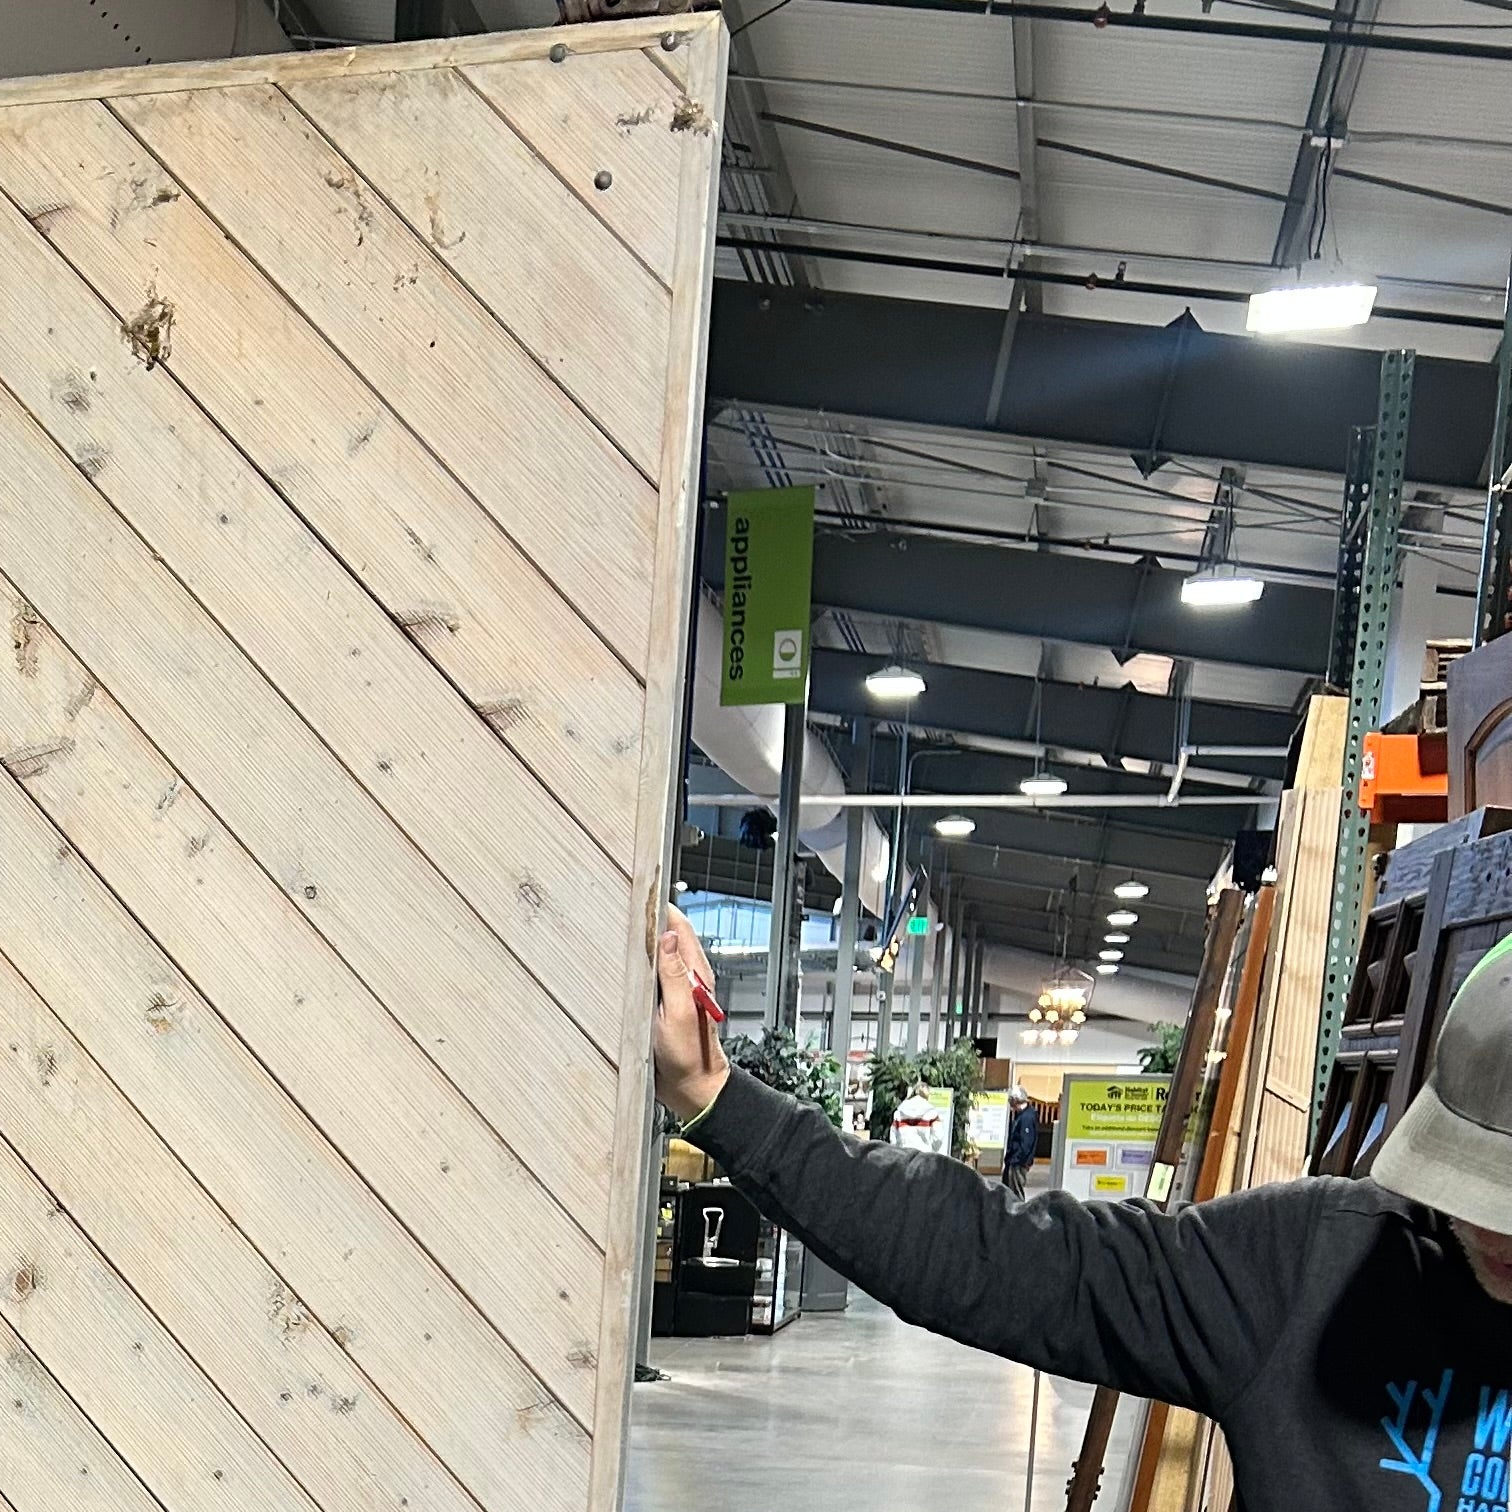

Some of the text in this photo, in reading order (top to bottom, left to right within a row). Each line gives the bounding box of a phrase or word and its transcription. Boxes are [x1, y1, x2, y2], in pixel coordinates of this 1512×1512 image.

[729, 517, 752, 681] appliances
[1080, 1102, 1121, 1112] TODAY'S
[1124, 1103, 1153, 1113] PRICE
